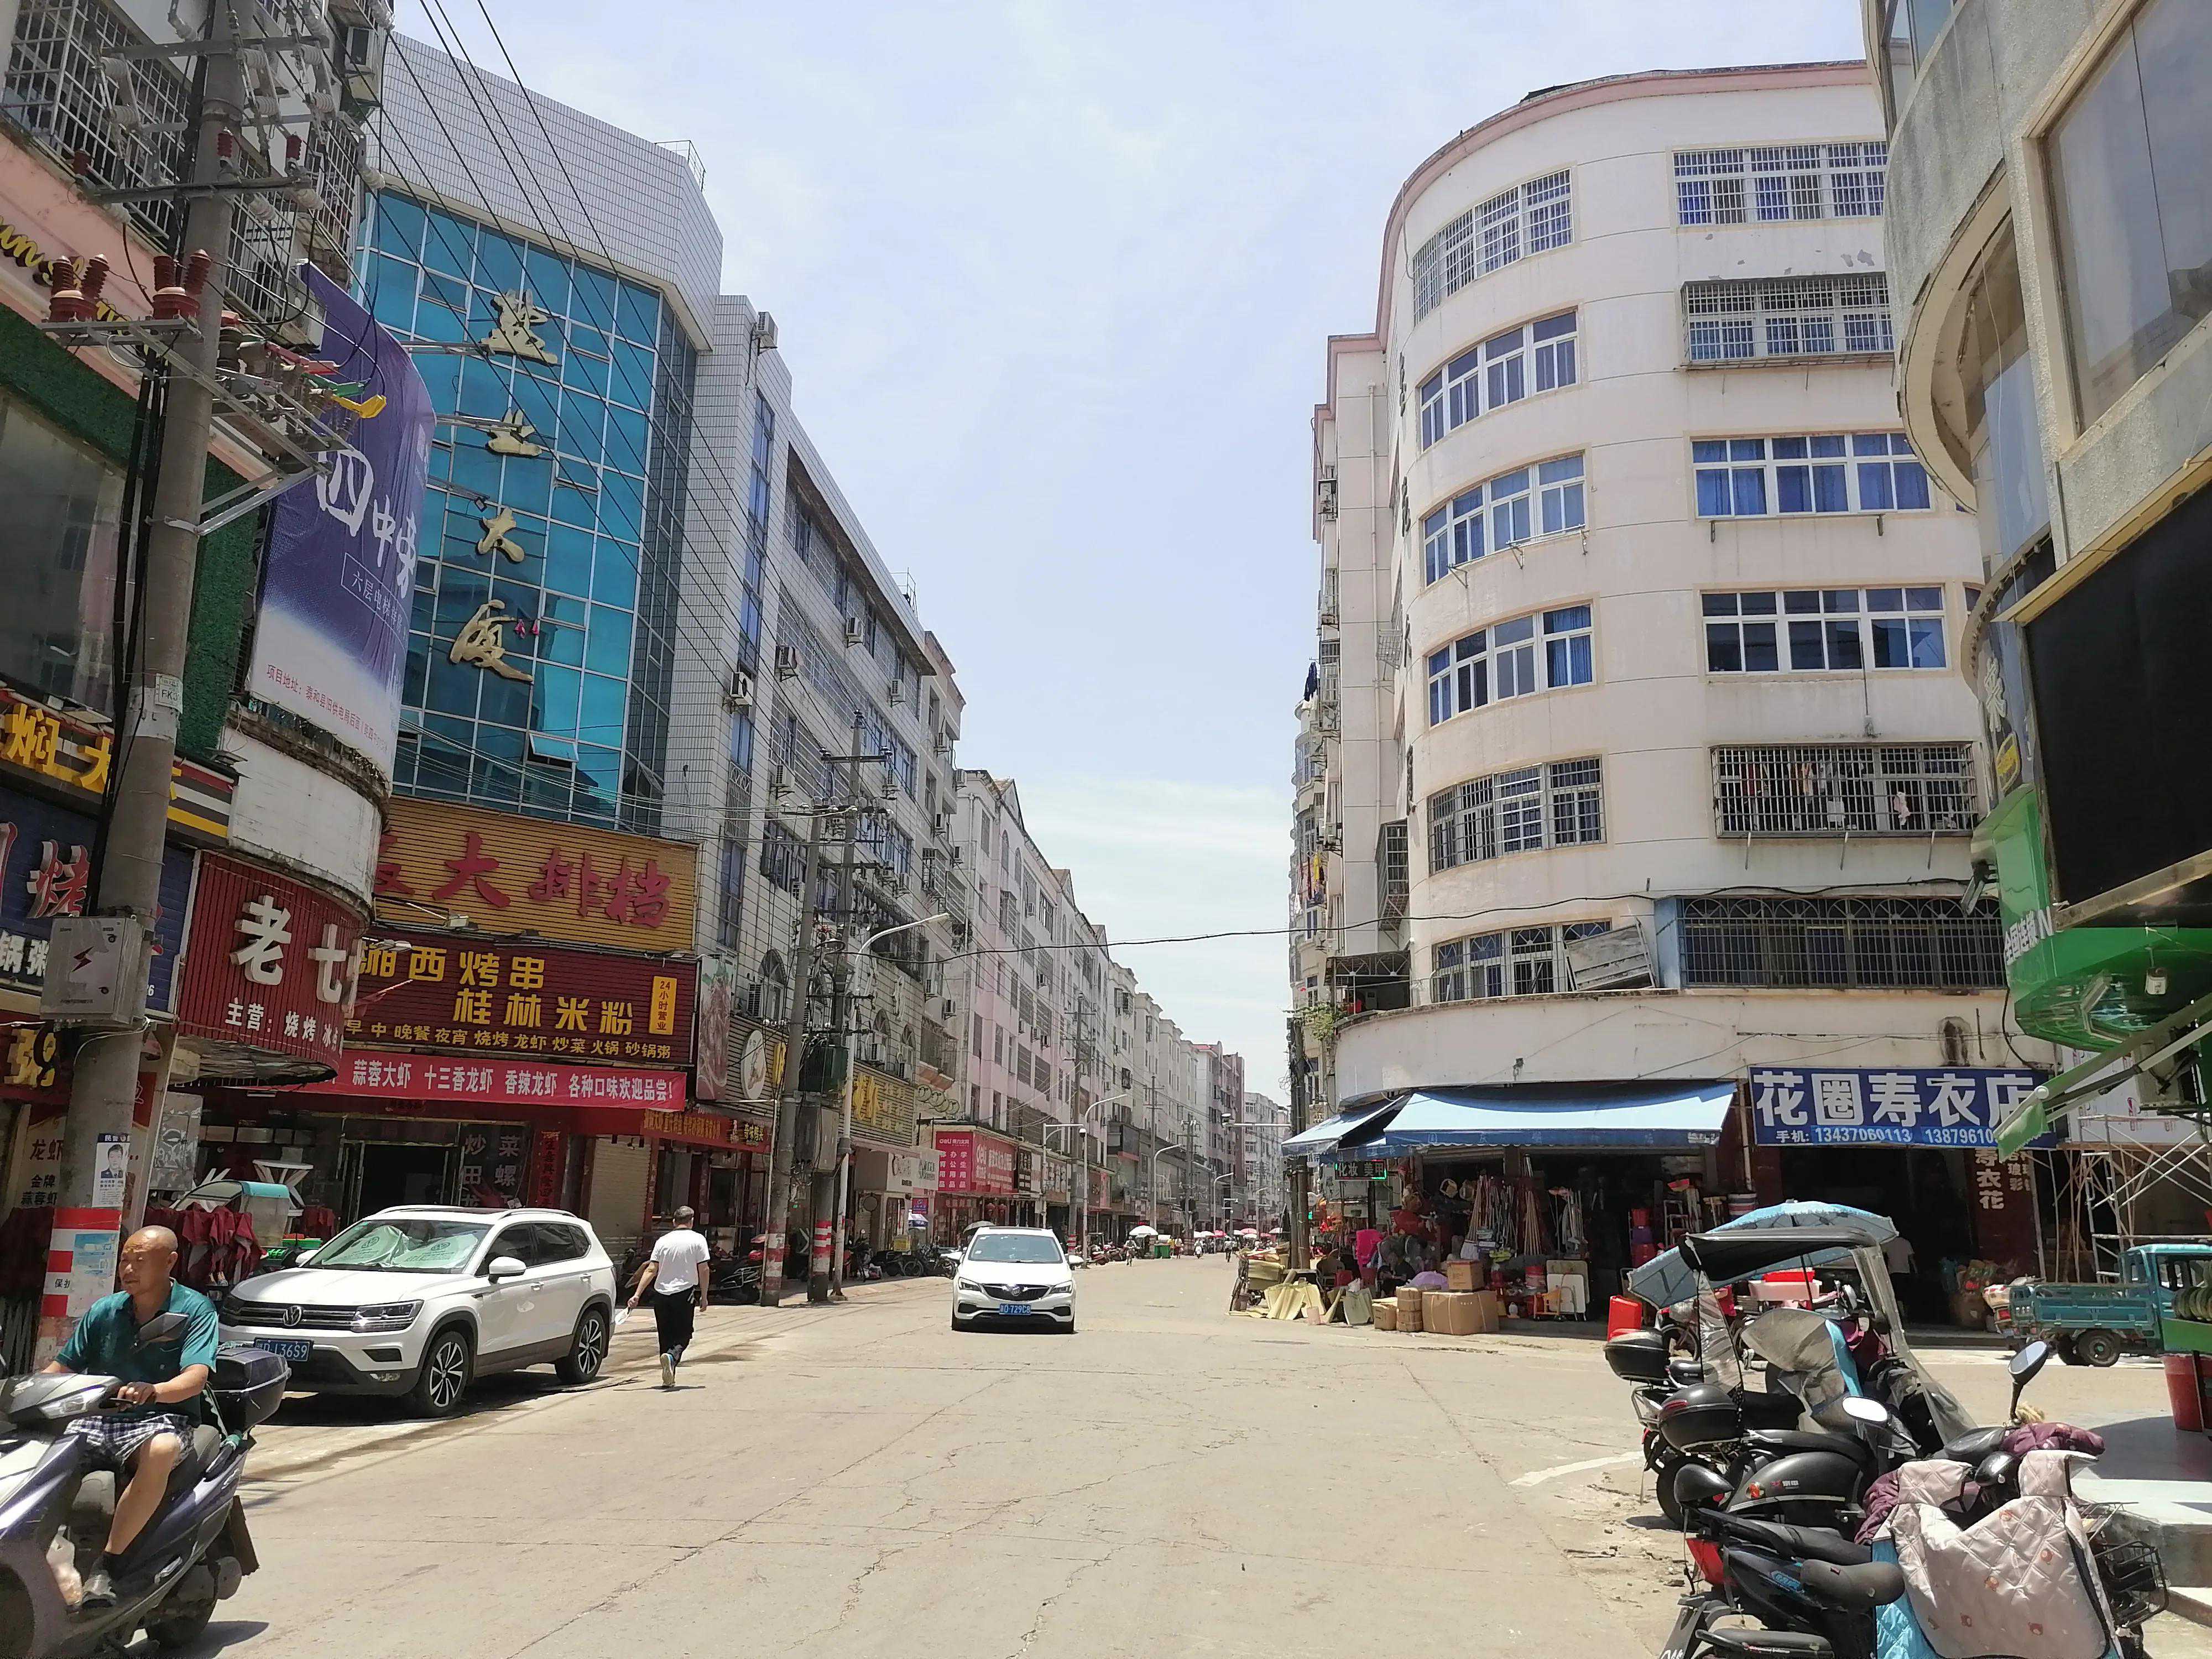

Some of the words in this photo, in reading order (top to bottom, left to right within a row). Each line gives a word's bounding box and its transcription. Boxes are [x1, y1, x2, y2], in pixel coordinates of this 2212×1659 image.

[452, 988, 633, 1036] 桂林米粉
[371, 1022, 387, 1038] 中
[394, 1023, 430, 1041] 晚餐
[435, 1027, 468, 1045] 夜宵
[474, 1030, 509, 1047] 烧烤
[513, 1034, 547, 1050] 龙虾
[552, 1036, 586, 1053] 炒菜
[590, 1039, 619, 1056] 火锅
[625, 1041, 670, 1058] 砂锅粥
[352, 1058, 412, 1088] 蒜蓉大虾
[424, 1064, 495, 1094] 十三香龙虾
[505, 1068, 558, 1098] 香辣龙虾
[568, 1073, 674, 1100] 各种口味欢迎品尝!
[1753, 1070, 2035, 1128] 花圈寿衣店
[1924, 1127, 1997, 1145] 13879610
